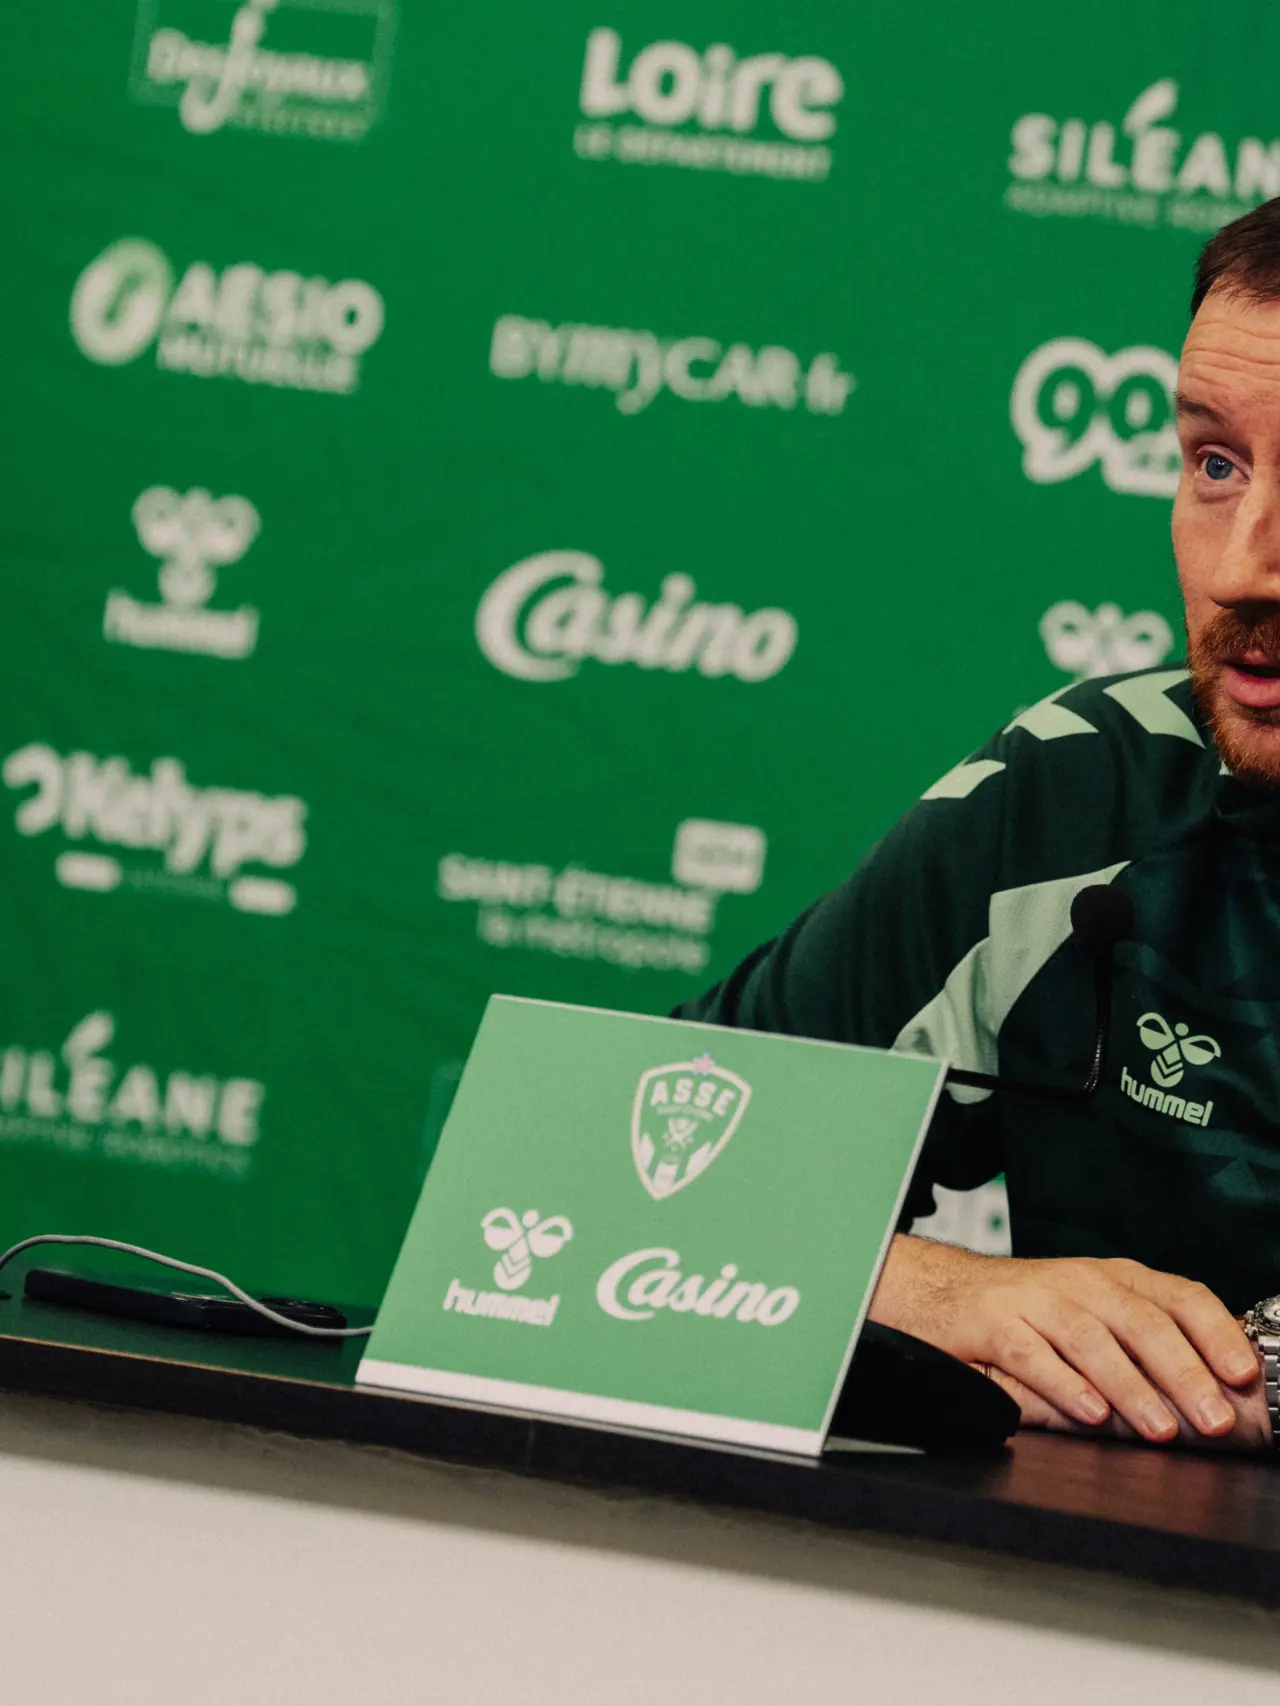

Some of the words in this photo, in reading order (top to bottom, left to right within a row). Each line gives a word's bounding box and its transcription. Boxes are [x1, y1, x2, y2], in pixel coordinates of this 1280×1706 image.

[475, 548, 798, 683] Casino
[650, 1077, 737, 1117] ASSE
[1120, 1066, 1214, 1127] hummel
[442, 1278, 560, 1327] hummel
[596, 1247, 800, 1327] Casino
